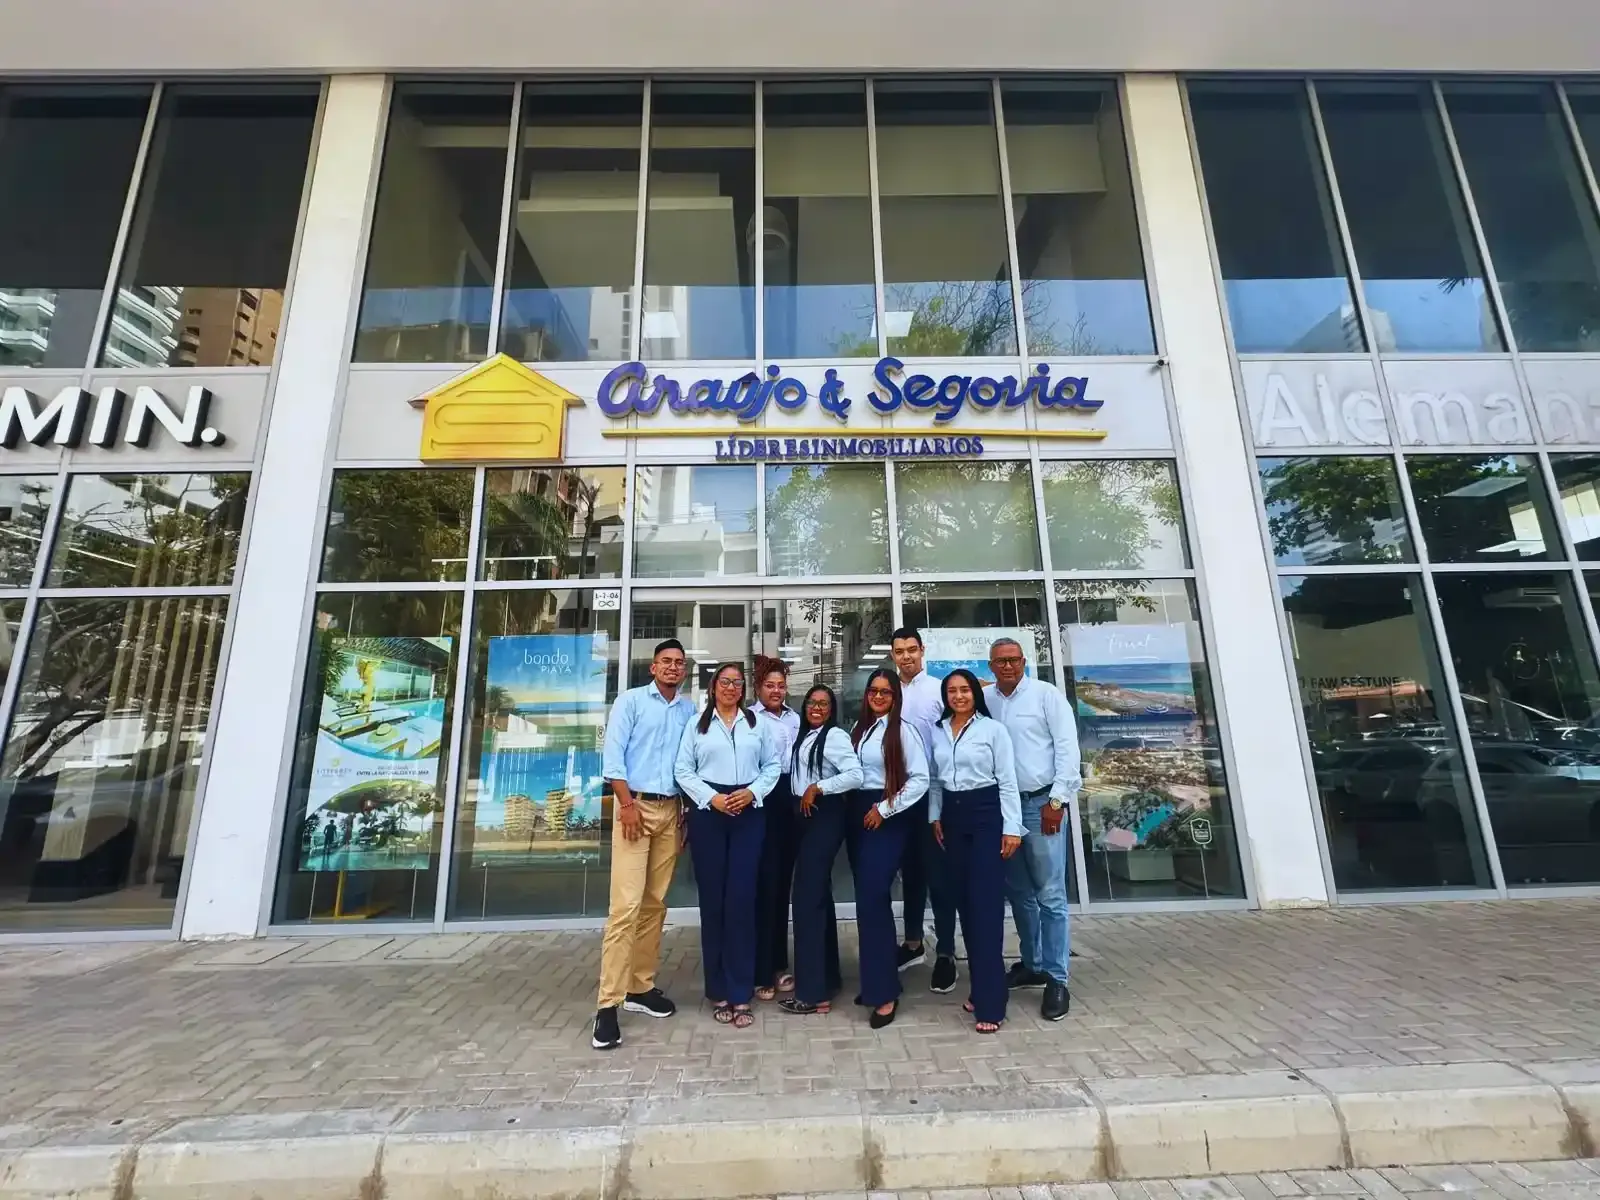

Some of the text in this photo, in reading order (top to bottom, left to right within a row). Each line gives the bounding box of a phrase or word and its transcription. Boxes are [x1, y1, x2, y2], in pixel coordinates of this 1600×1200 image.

[0, 386, 224, 449] MIN.
[867, 356, 1104, 423] Segovia
[1256, 372, 1600, 446] Aleman
